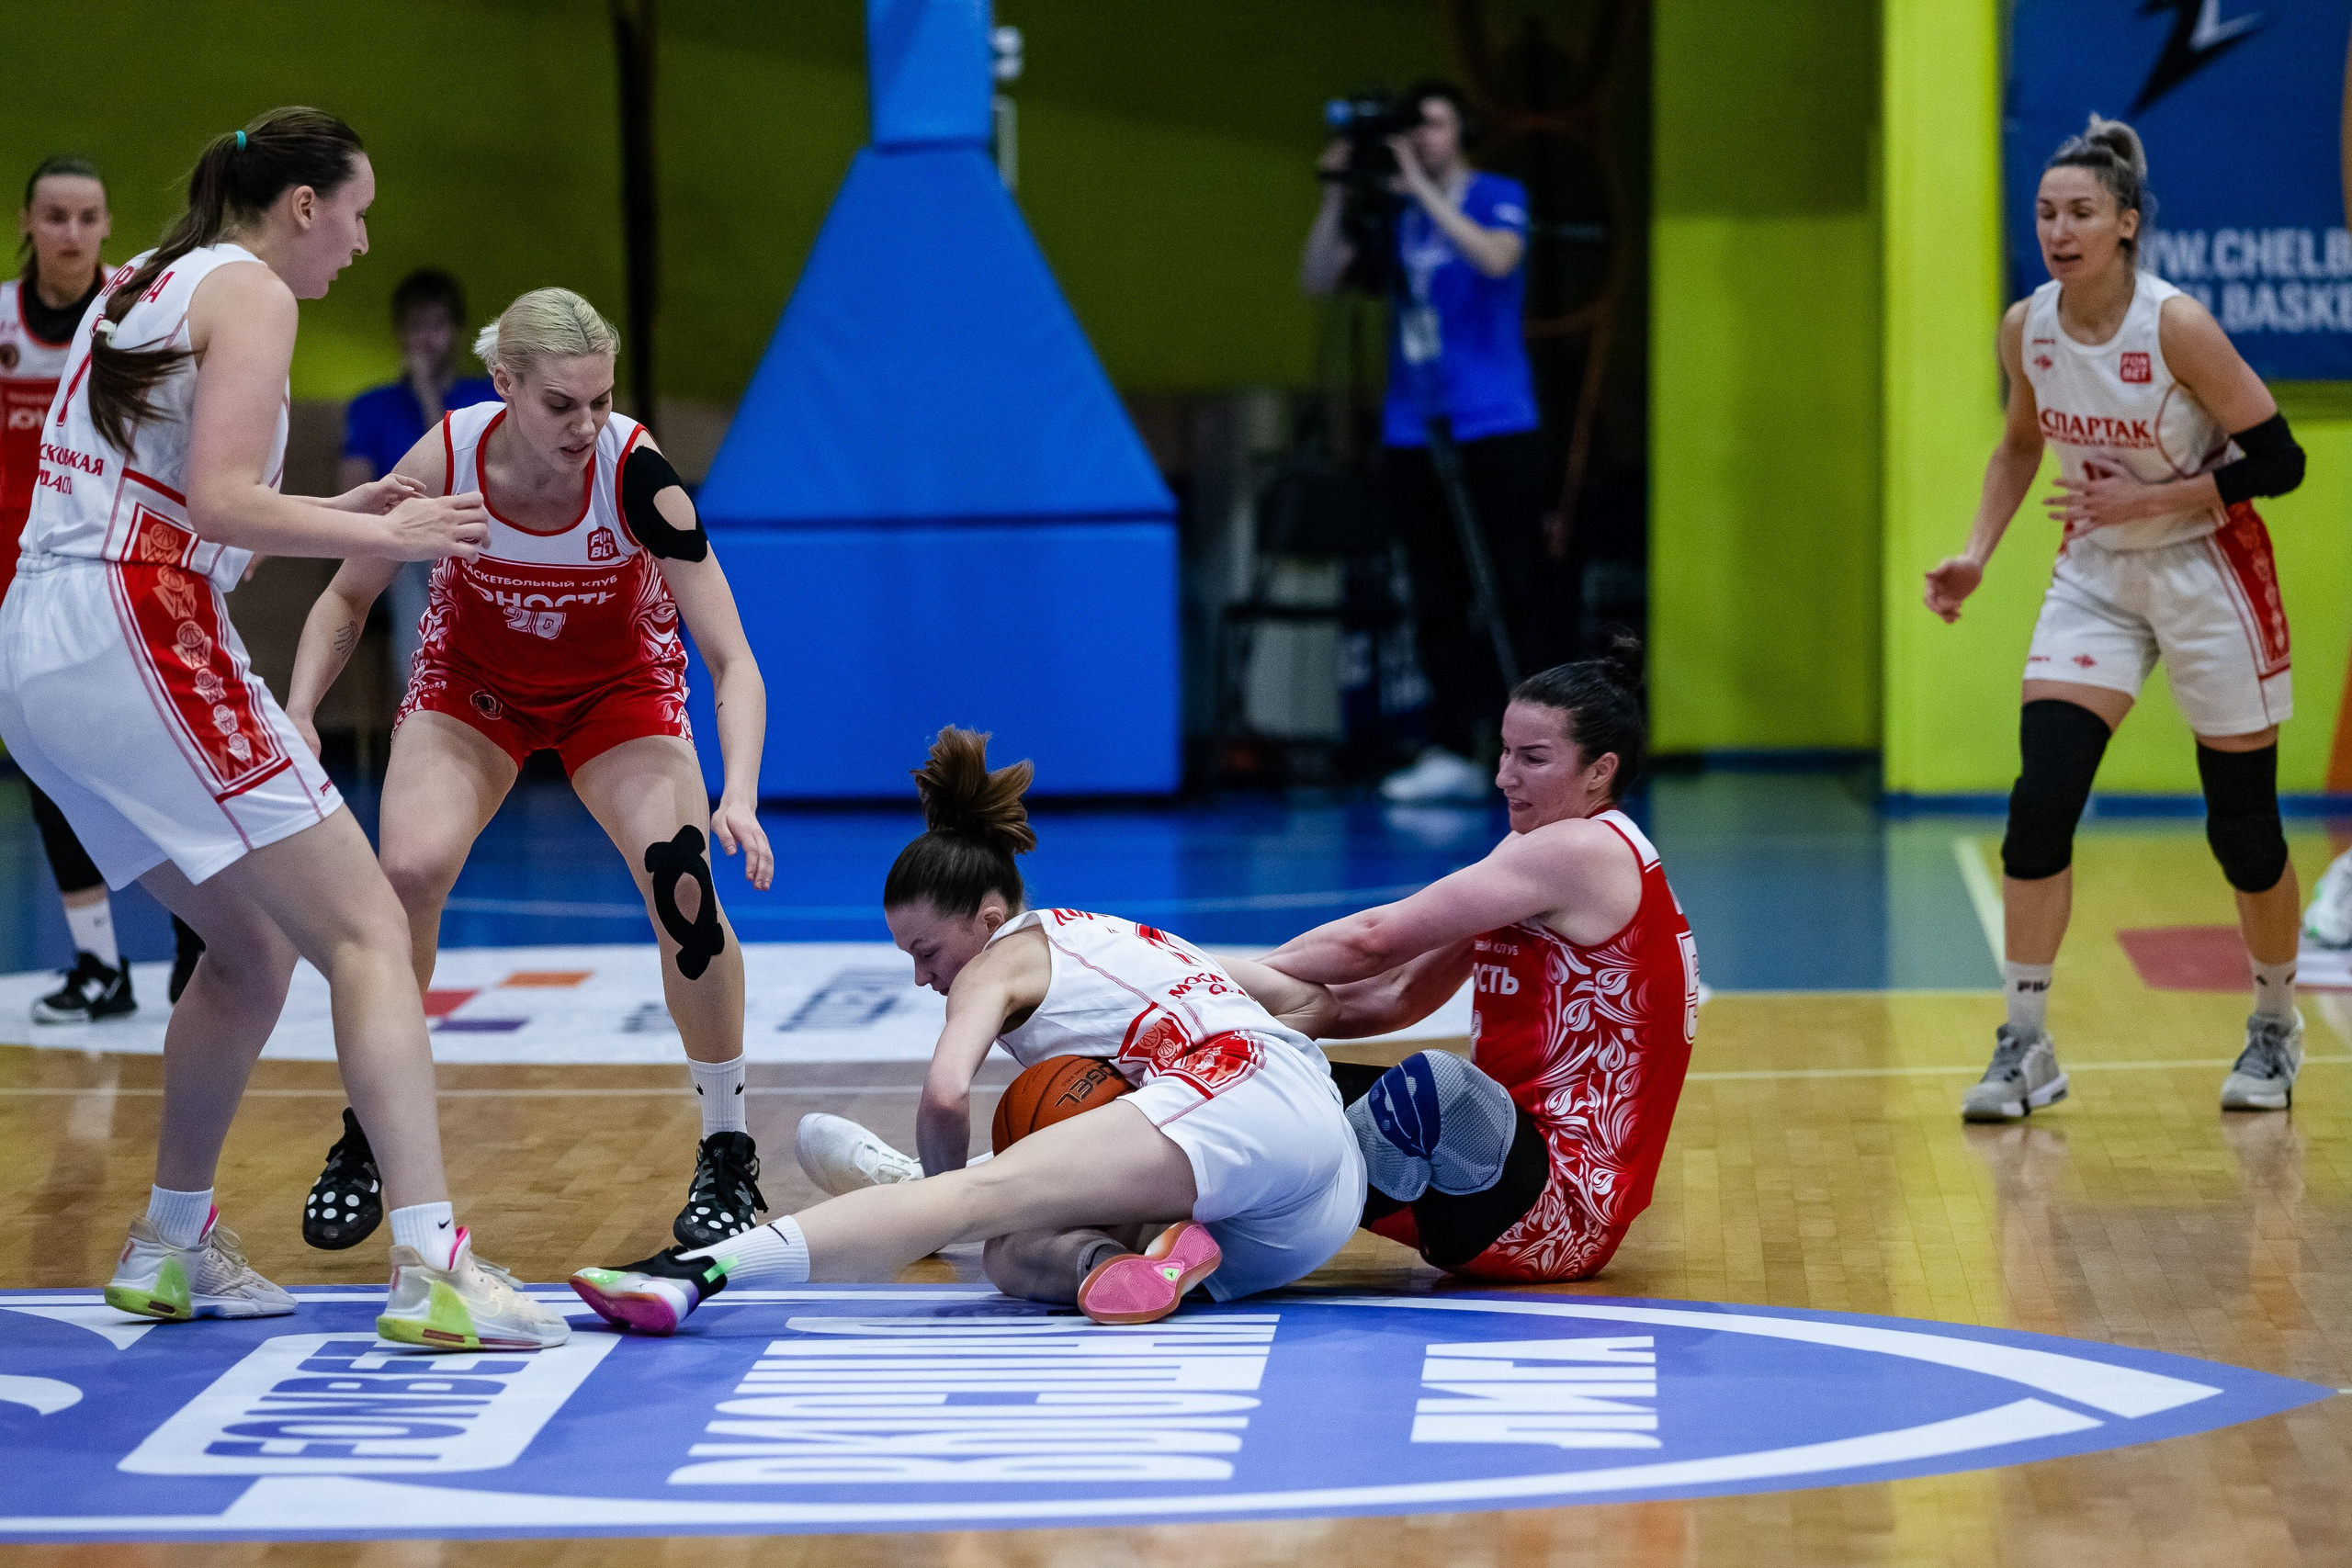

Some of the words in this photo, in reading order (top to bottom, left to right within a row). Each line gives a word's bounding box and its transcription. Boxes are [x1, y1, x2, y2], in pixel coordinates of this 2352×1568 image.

[2041, 408, 2151, 439] СПАРТАК
[461, 558, 575, 588] БАСКЕТБОЛЬНЫЙ
[582, 575, 618, 588] КЛУБ
[666, 1314, 1281, 1485] ВЫСШАЯ
[1409, 1336, 1663, 1450] ЛИГА
